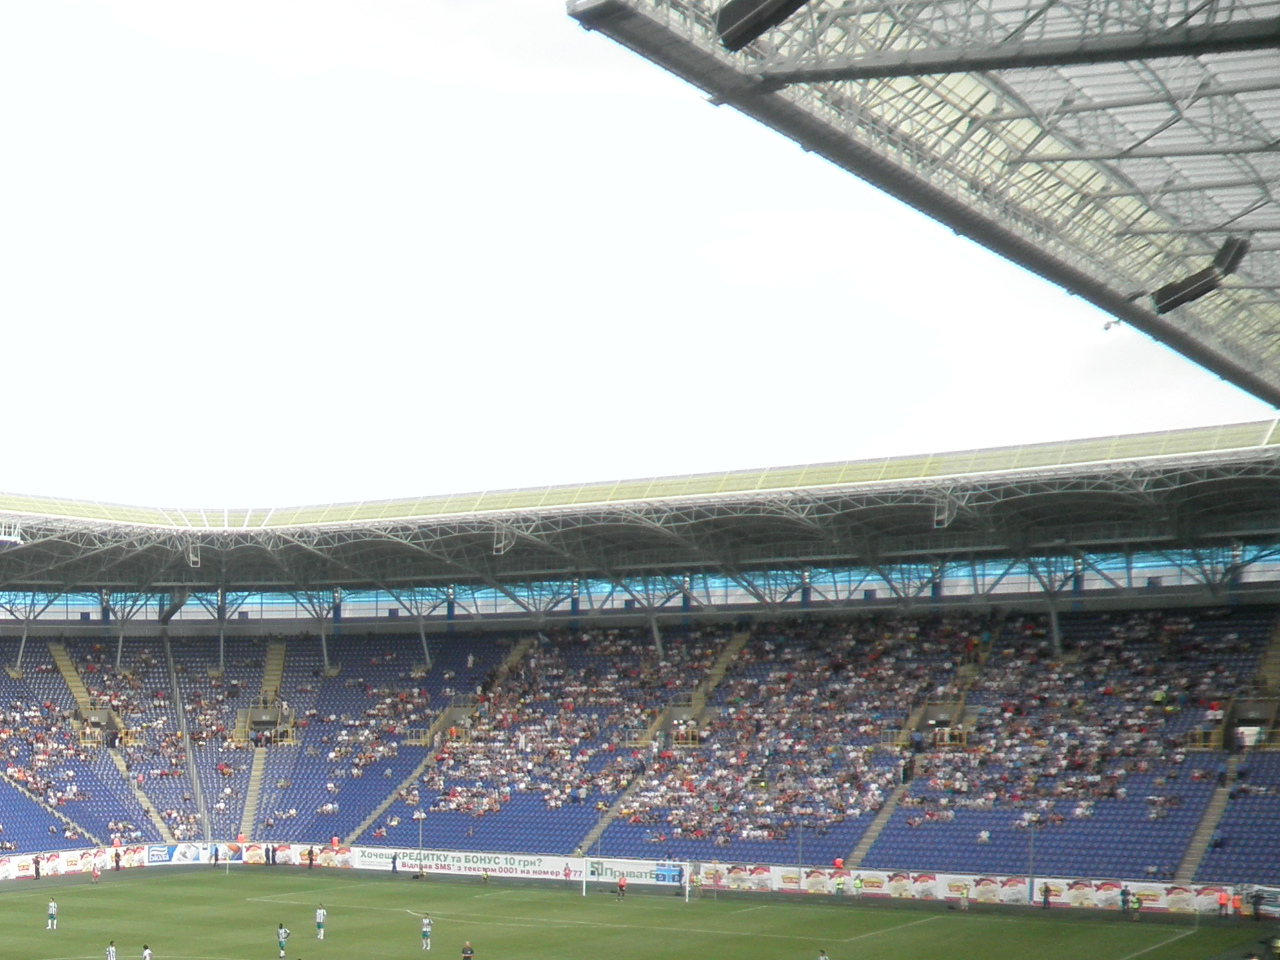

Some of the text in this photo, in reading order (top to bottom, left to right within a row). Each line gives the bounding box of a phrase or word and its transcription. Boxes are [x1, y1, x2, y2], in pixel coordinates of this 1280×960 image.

[396, 851, 449, 862] КРЕДИТКУ
[464, 855, 500, 865] БОНУС
[504, 857, 515, 866] 10
[518, 858, 542, 868] грн?
[533, 869, 561, 877] номер
